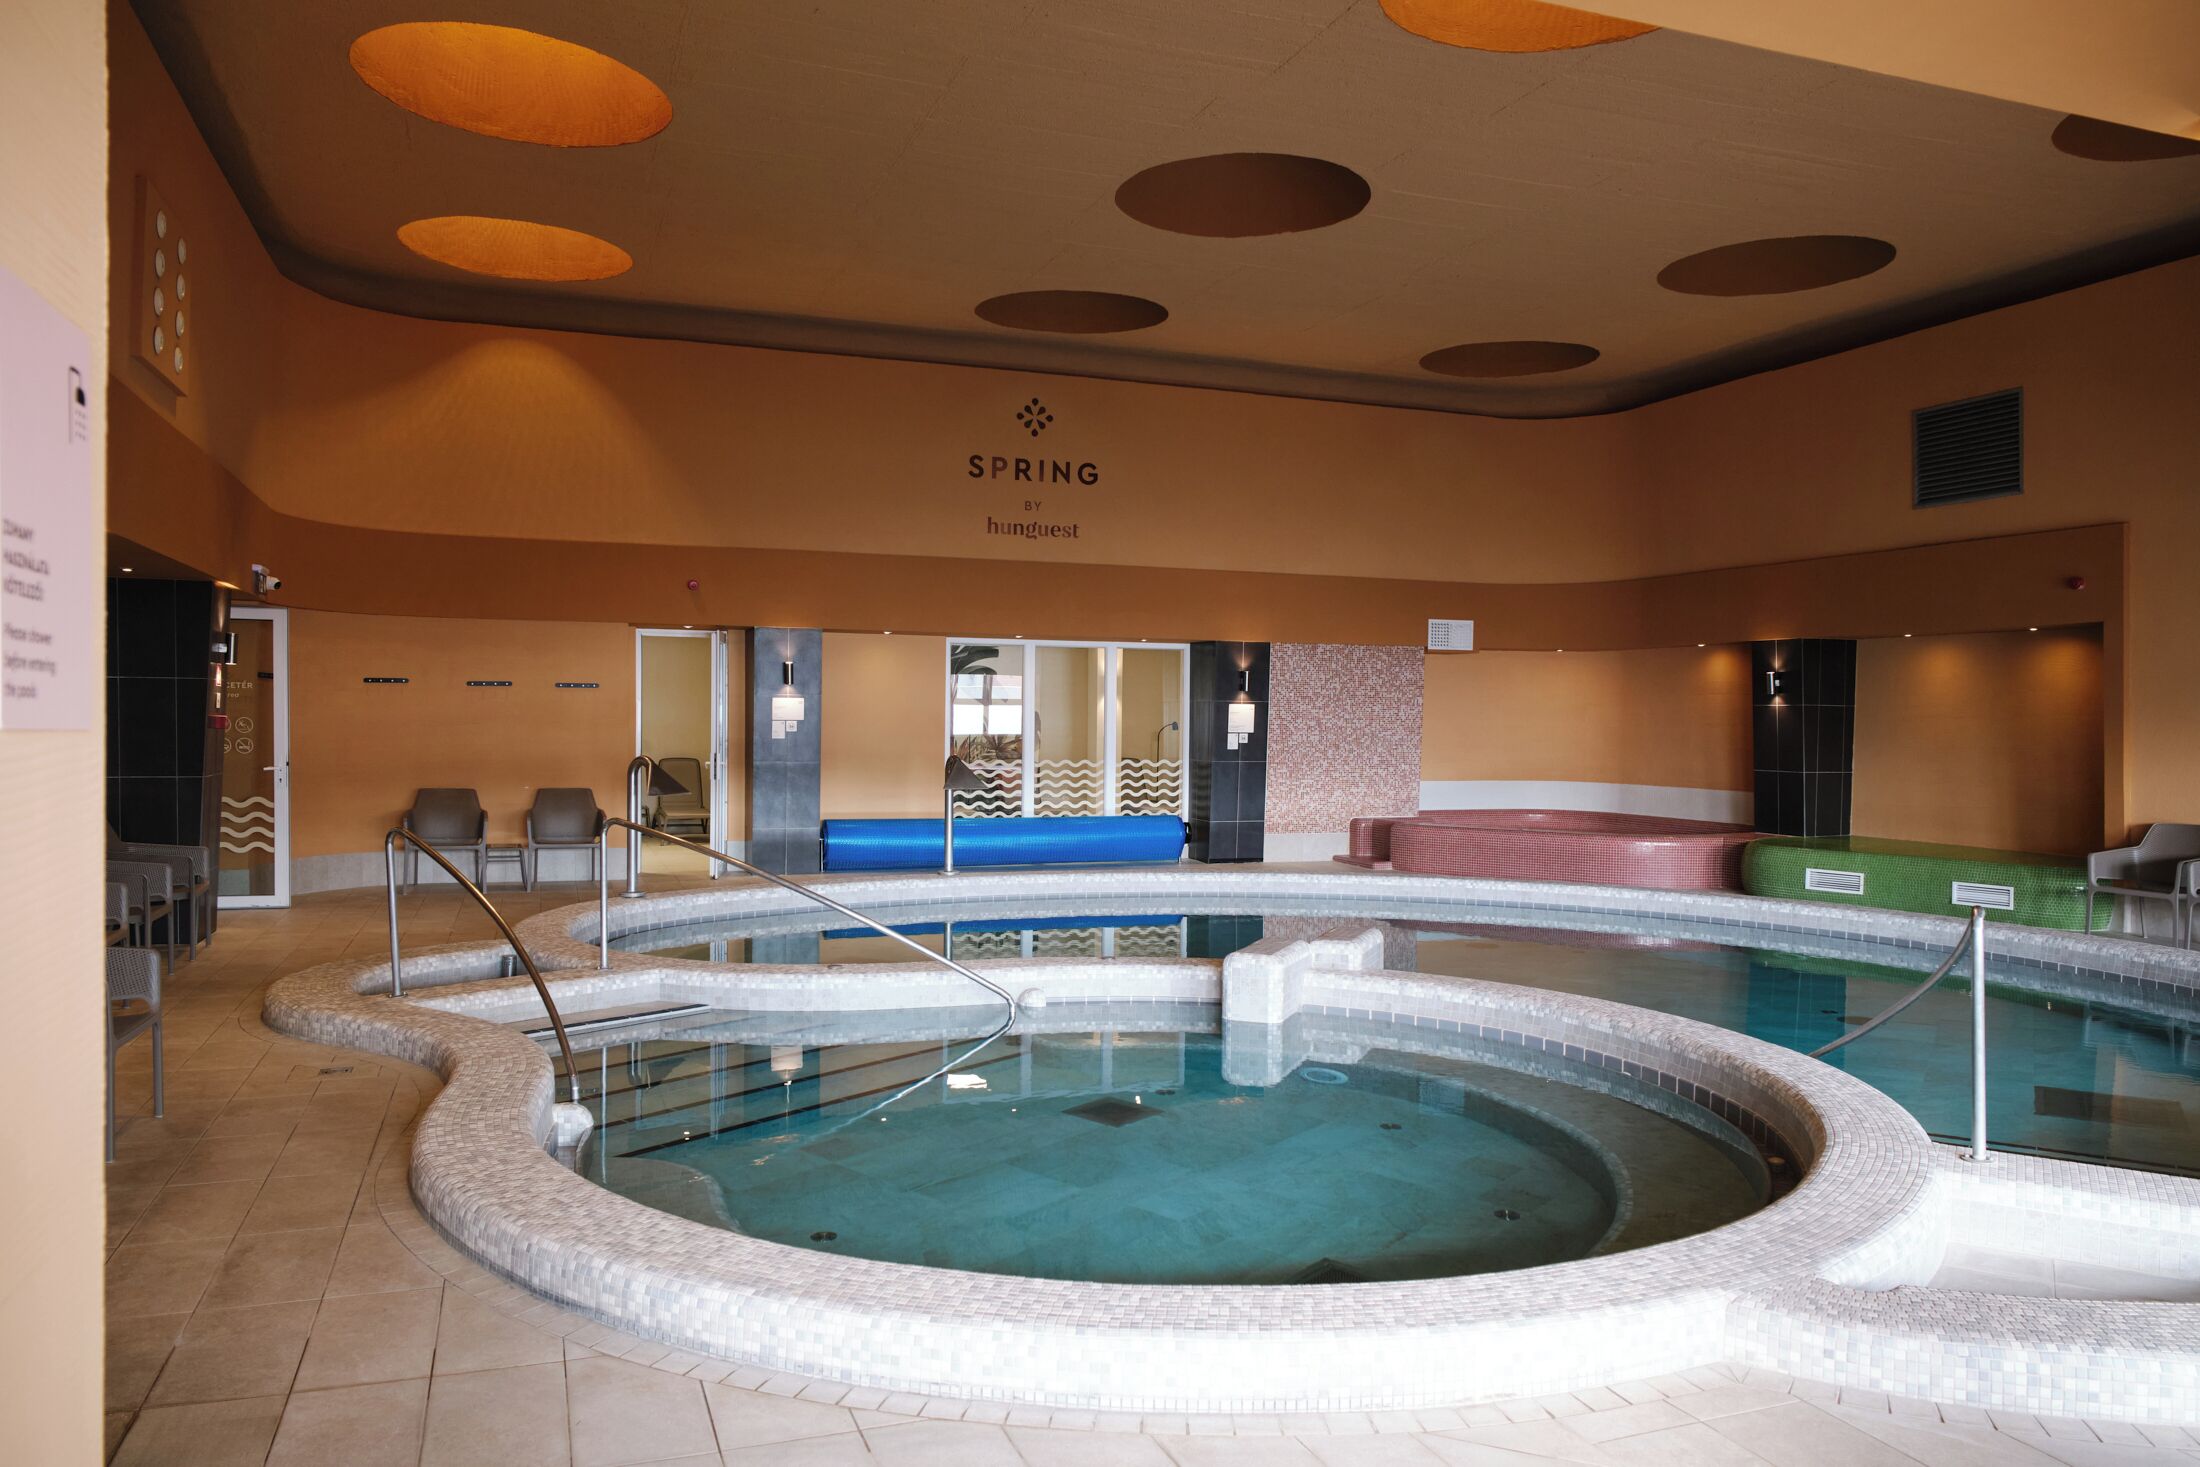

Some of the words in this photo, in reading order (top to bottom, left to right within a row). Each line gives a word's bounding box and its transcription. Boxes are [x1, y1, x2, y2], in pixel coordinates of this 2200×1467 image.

[968, 454, 1099, 486] SPRING
[1024, 500, 1042, 511] BY
[986, 516, 1080, 540] hunguest
